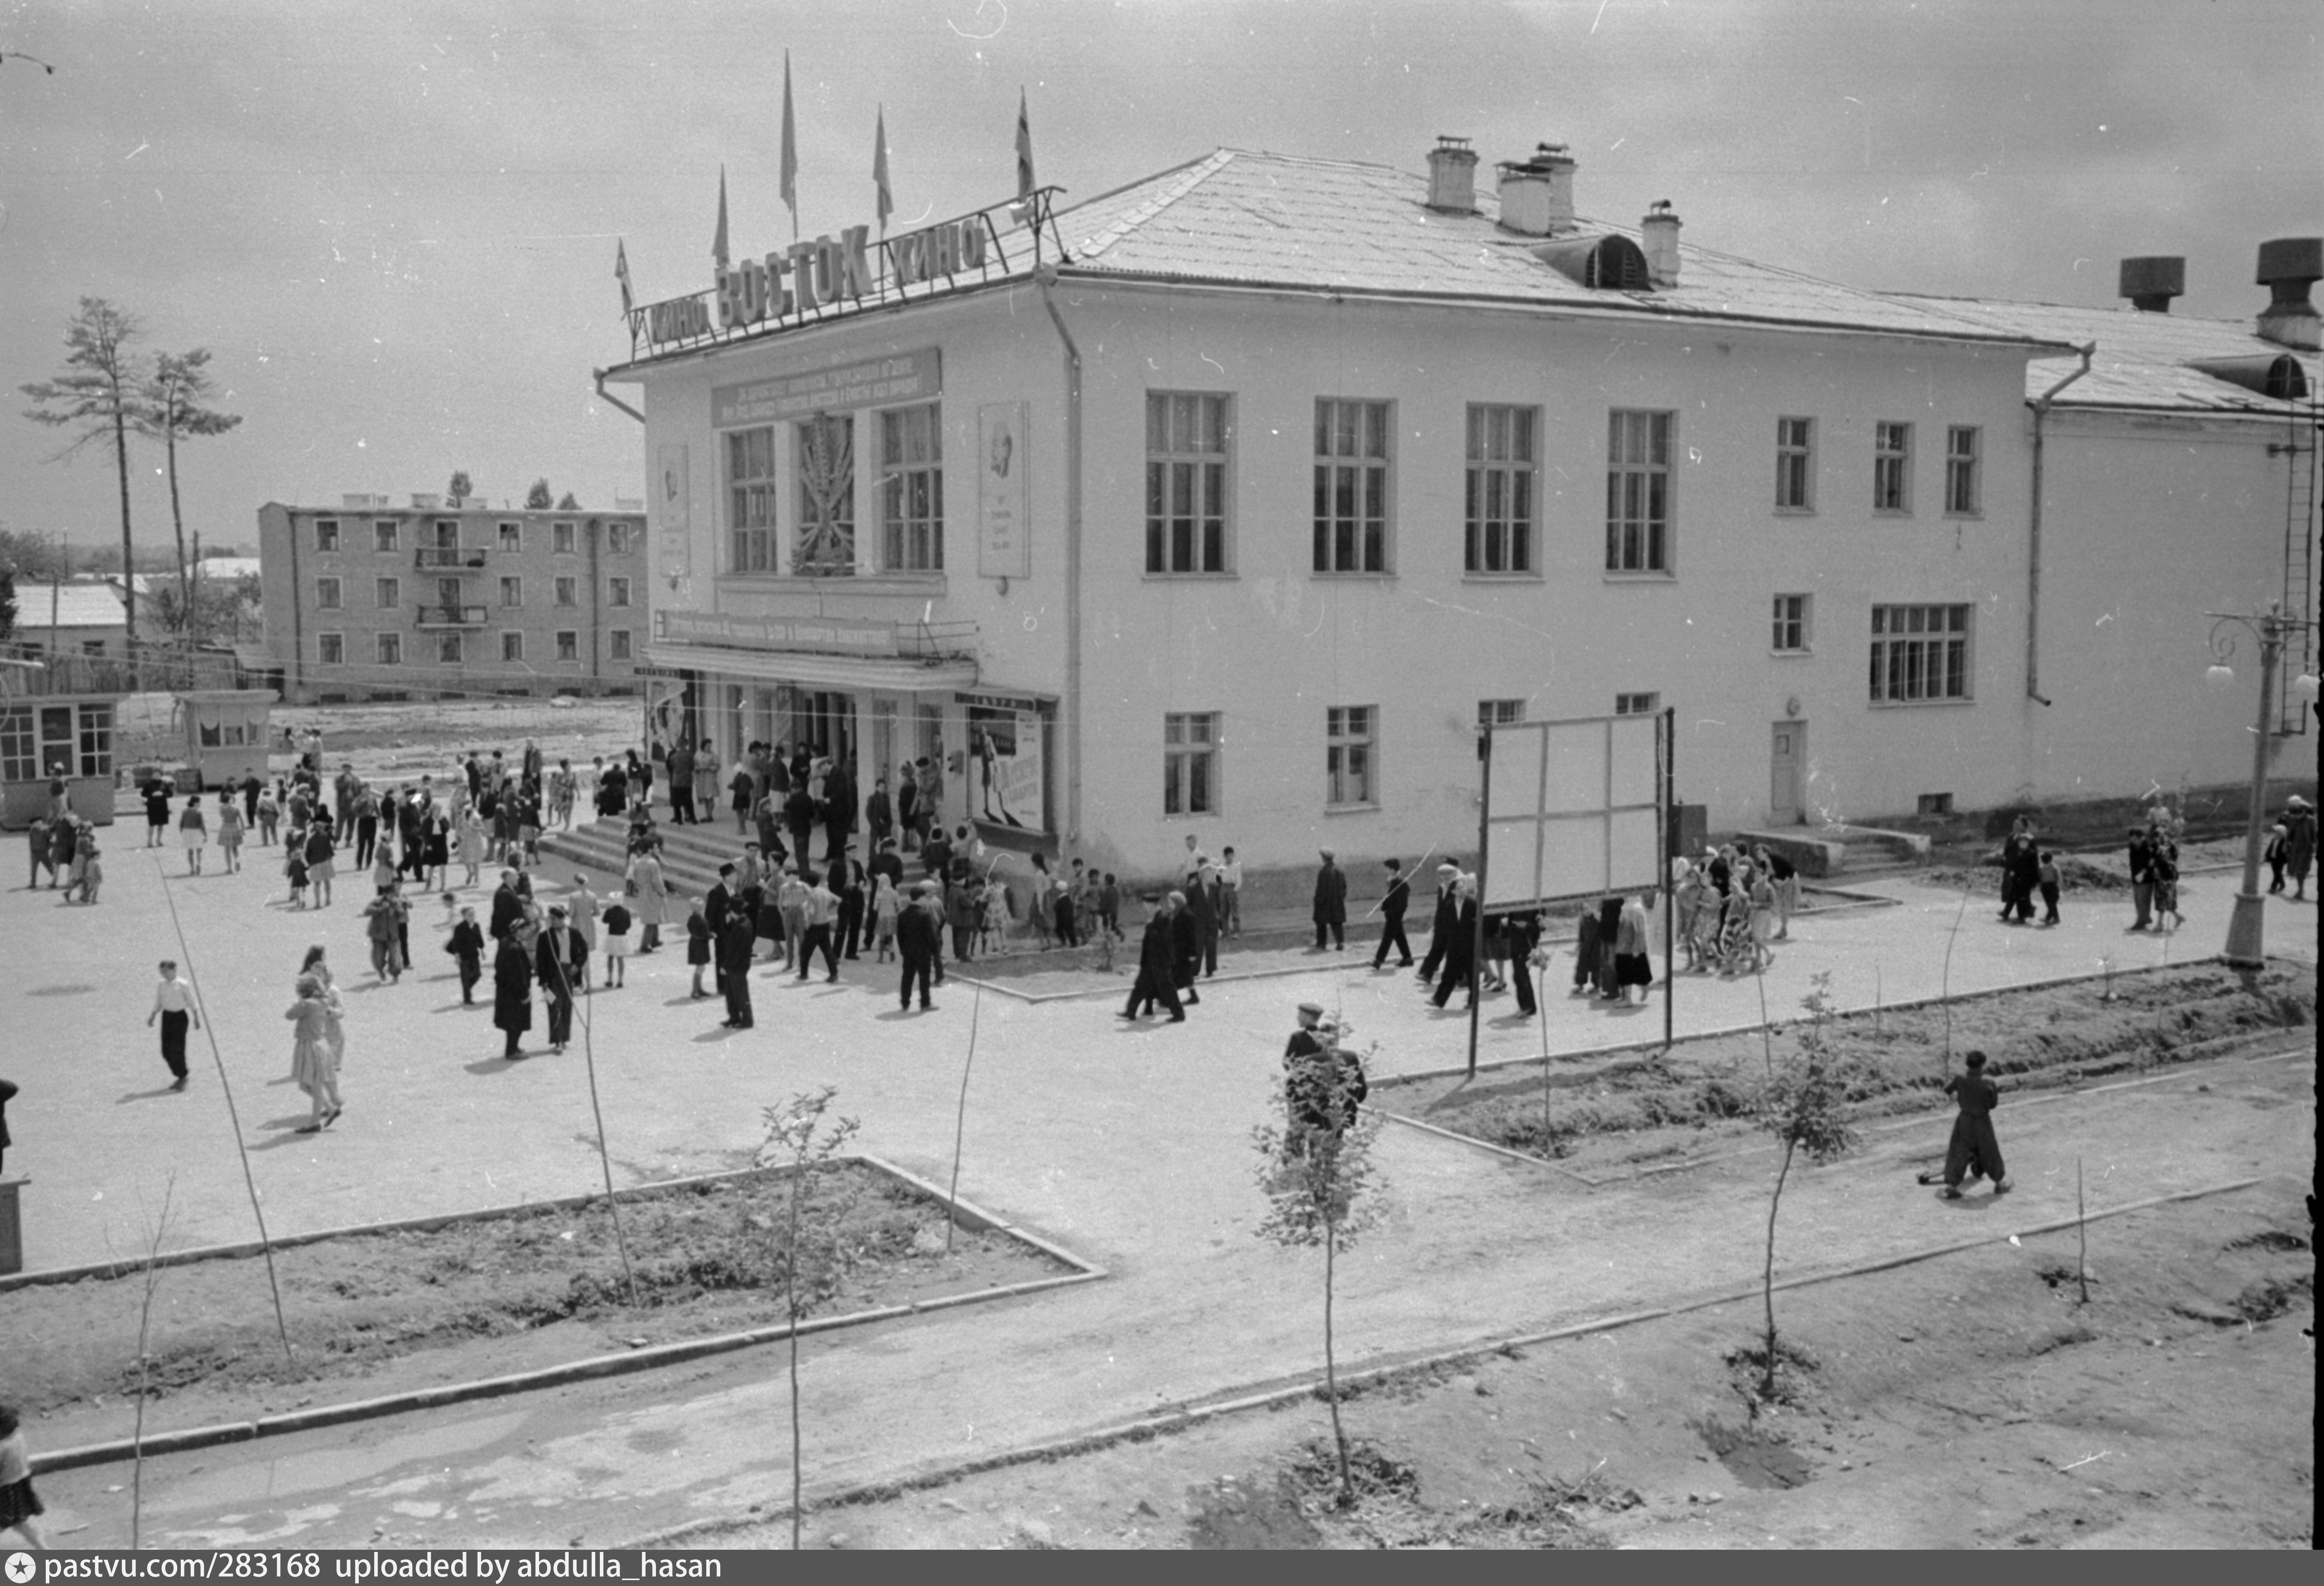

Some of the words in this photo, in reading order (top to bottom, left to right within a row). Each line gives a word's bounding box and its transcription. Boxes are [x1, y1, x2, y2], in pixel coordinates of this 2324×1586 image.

[651, 297, 709, 343] КИНО
[714, 225, 875, 326] ВОСТОК
[892, 219, 986, 287] КИНО
